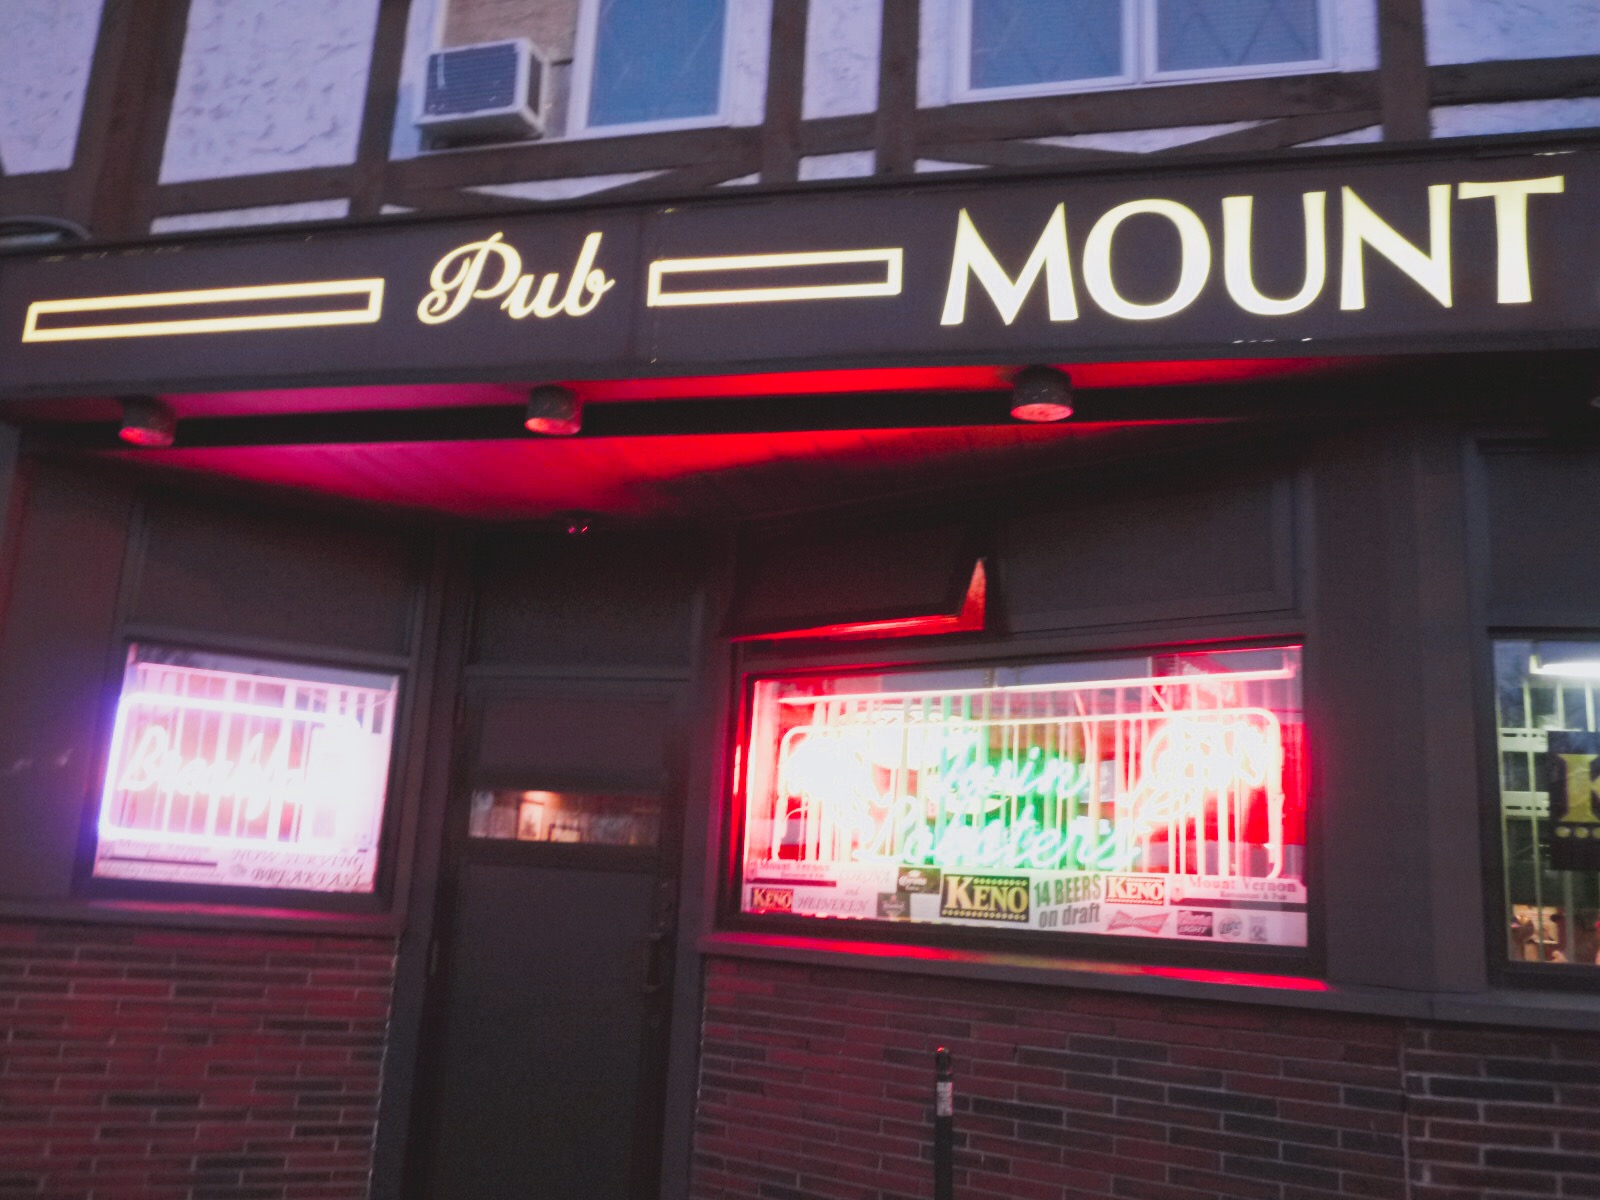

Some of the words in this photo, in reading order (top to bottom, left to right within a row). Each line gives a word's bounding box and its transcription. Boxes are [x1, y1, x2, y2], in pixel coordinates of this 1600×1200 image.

[939, 175, 1565, 327] MOUNT
[417, 231, 616, 325] Pub
[944, 876, 1028, 913] KENO
[1033, 880, 1051, 907] 14
[1054, 873, 1100, 905] BEERS
[1106, 876, 1165, 902] KENO
[1190, 876, 1235, 889] Mount
[1243, 878, 1297, 893] Vernon
[1039, 910, 1058, 928] on
[1062, 902, 1100, 926] draft
